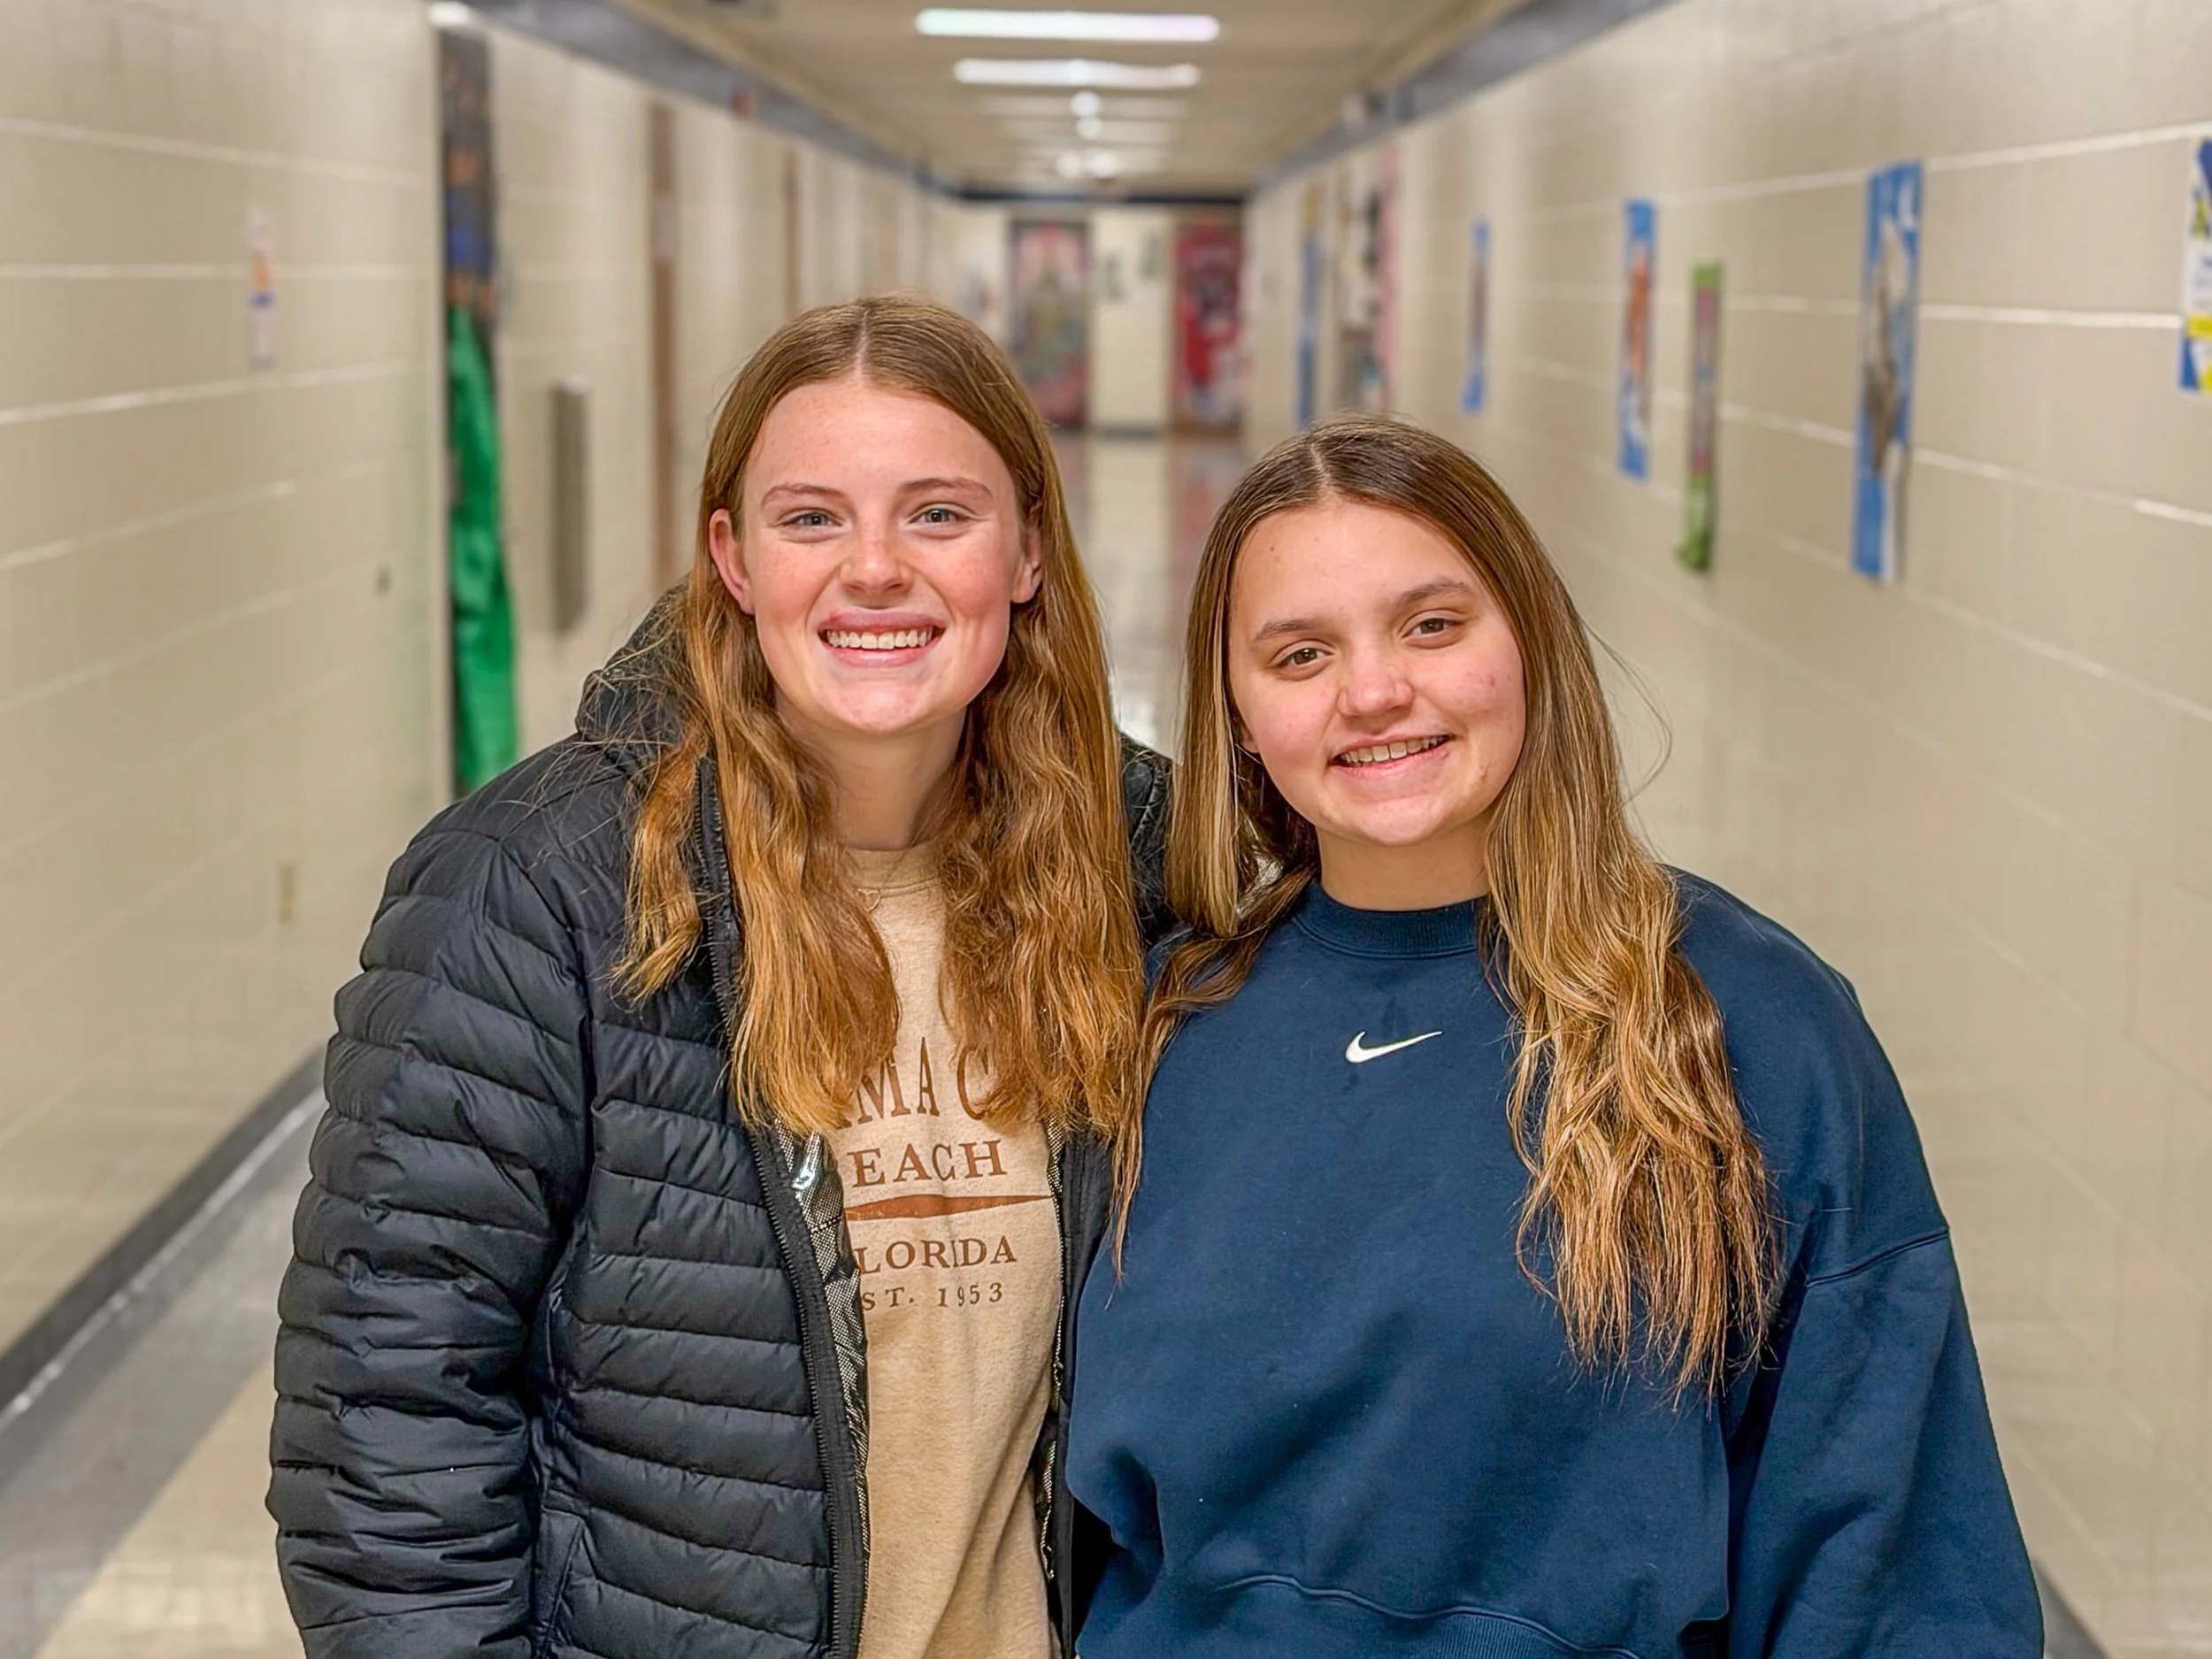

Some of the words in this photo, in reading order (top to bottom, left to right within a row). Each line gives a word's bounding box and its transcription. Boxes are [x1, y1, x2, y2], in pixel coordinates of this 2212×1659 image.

[836, 1036, 941, 1130] MA
[847, 1139, 1008, 1188] EACH
[854, 1235, 1018, 1275] LORIDA
[862, 1286, 914, 1311] ST.
[938, 1282, 1002, 1308] 1953
